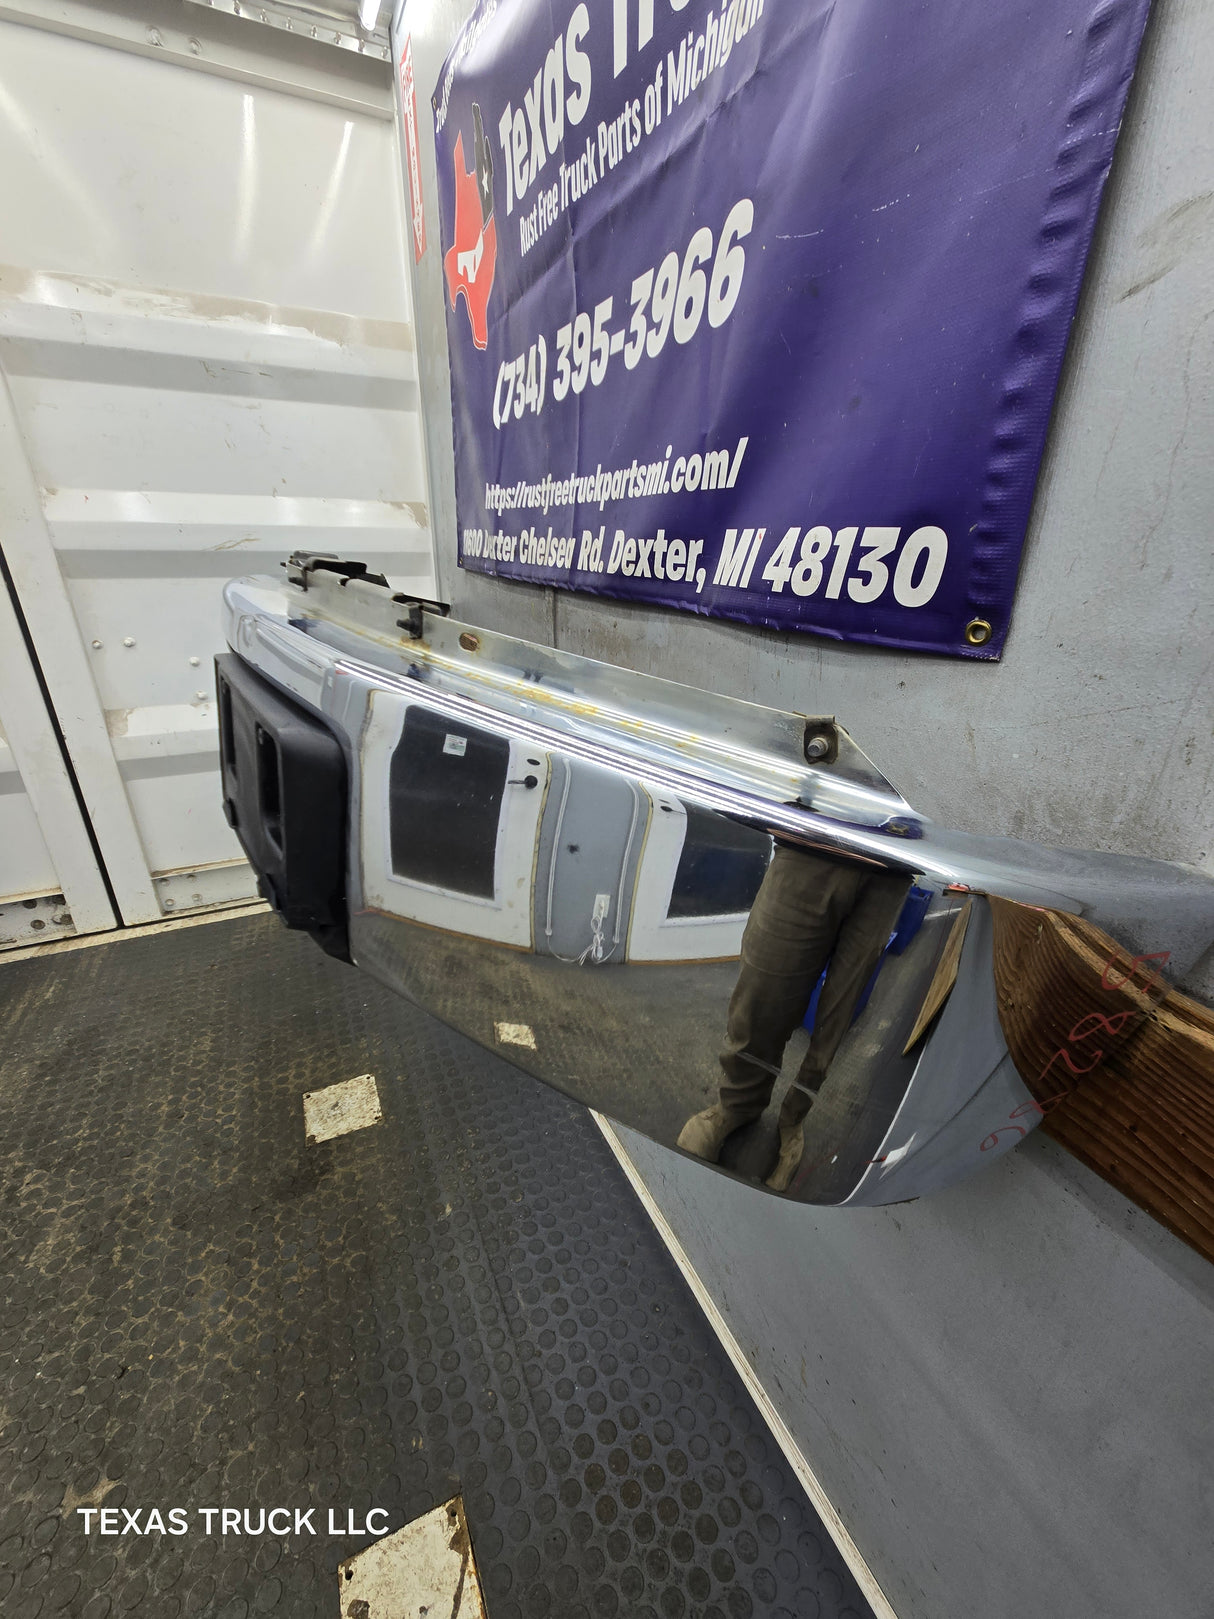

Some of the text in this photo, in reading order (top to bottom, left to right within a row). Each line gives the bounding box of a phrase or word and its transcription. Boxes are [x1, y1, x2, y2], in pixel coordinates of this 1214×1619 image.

[499, 3, 592, 217] Texas
[519, 203, 539, 257] Rust
[538, 183, 559, 237] Free
[559, 136, 598, 212] Truck
[597, 99, 642, 178] Parts
[644, 60, 663, 135] of
[493, 198, 755, 430] (734) 395-3966
[485, 436, 749, 516] https://rustfreetruckpartsmi.com/
[519, 526, 576, 569] Chelsea
[577, 526, 606, 573] Rd.
[606, 529, 707, 594] Dexter,
[712, 528, 767, 589] MI
[762, 525, 949, 608] 48130
